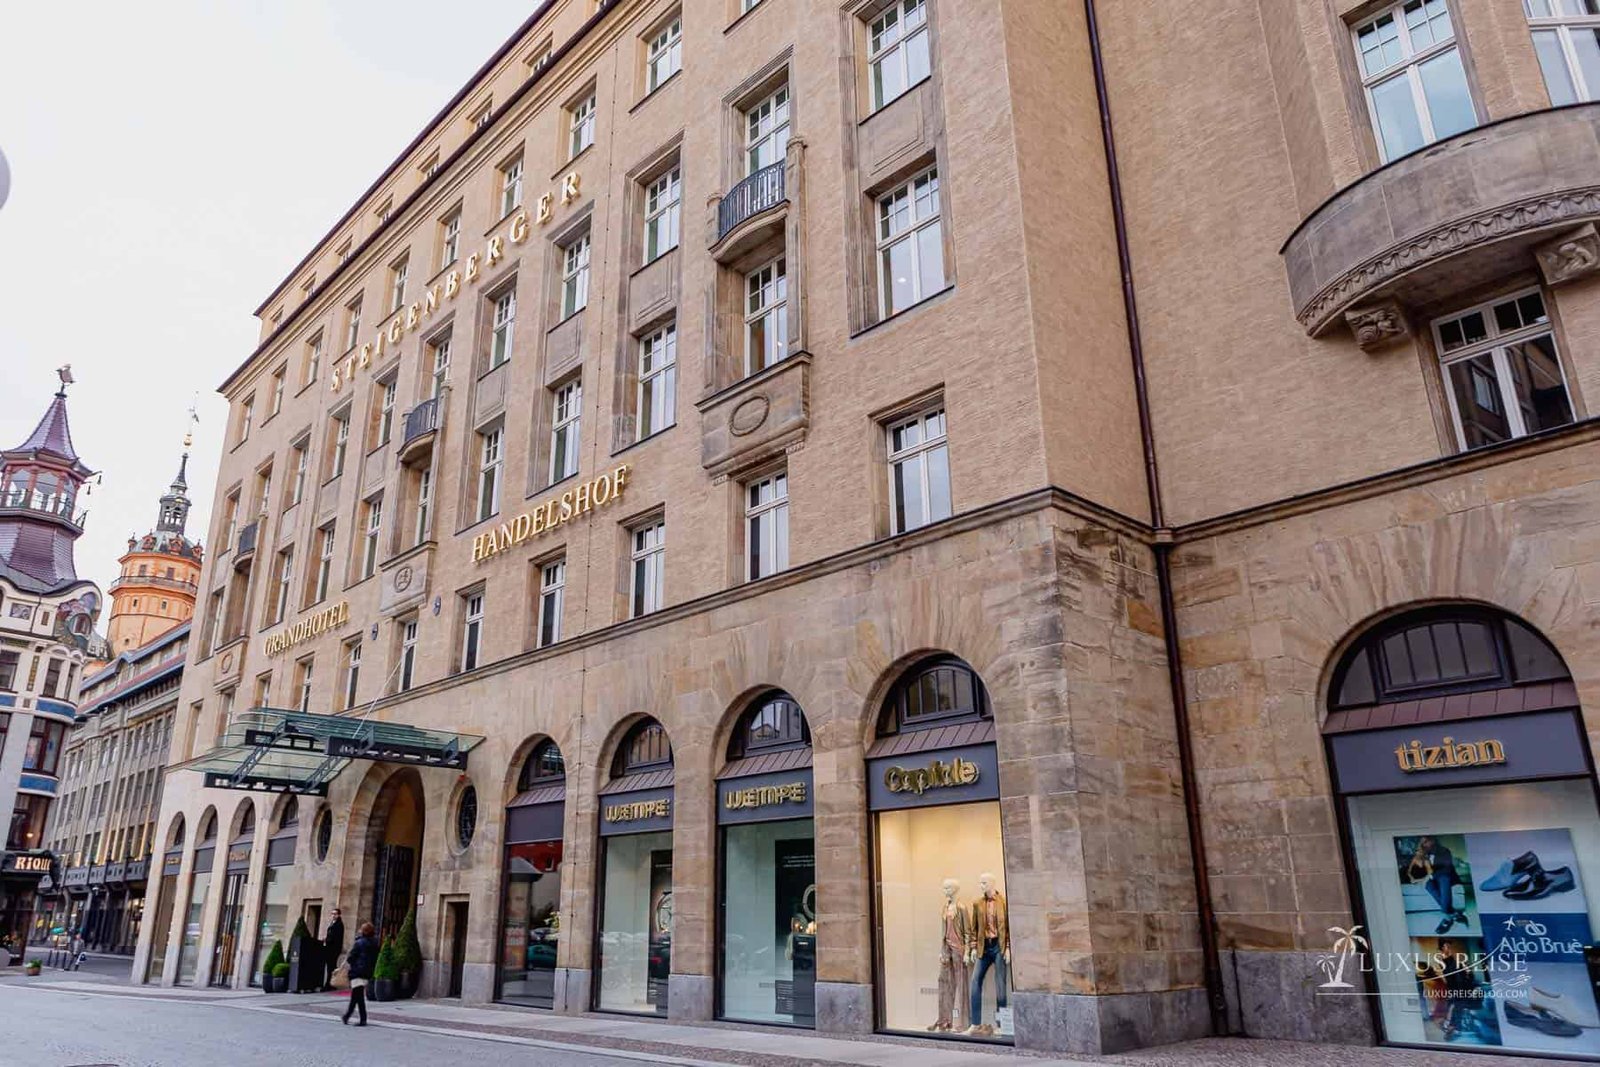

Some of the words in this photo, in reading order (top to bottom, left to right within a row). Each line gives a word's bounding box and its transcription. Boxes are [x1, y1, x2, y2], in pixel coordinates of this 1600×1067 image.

[330, 171, 580, 393] STEIGENBERGER
[471, 464, 630, 563] HANDELSHOF
[263, 600, 348, 657] GRANDHOTEL
[1394, 736, 1505, 772] tizian
[605, 798, 670, 822] WEMPE
[725, 782, 806, 809] WEMPE
[1500, 937, 1538, 954] Aldo
